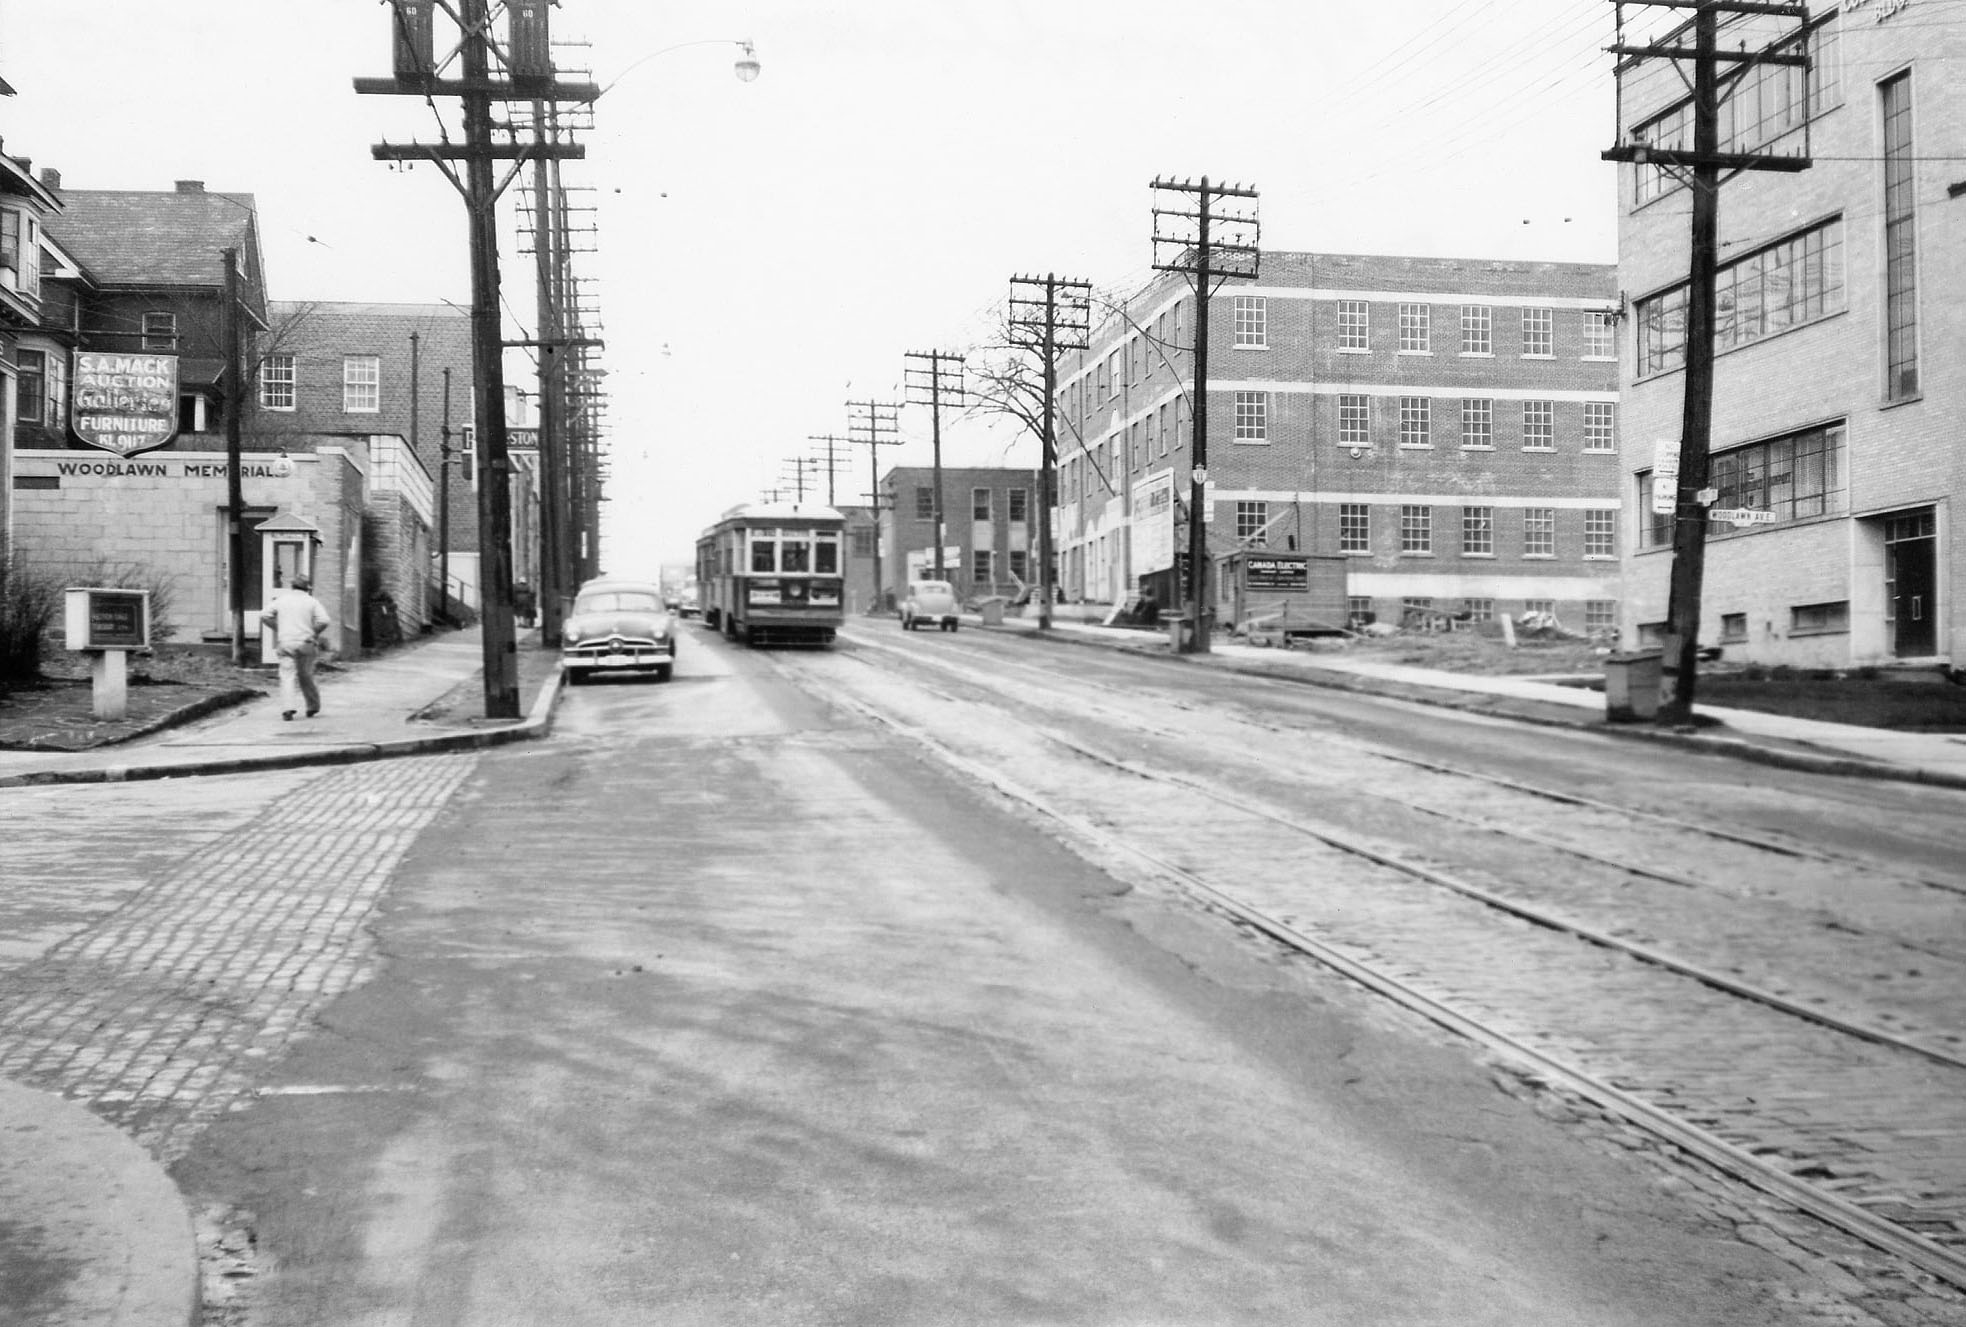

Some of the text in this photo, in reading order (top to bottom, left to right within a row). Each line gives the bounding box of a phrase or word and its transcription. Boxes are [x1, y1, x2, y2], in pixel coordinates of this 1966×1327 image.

[79, 374, 170, 388] AUCTION
[76, 388, 171, 411] Galleries
[79, 416, 168, 432] FURNITURE
[58, 462, 279, 479] WOODLAWN MEMRIAL
[1711, 510, 1751, 521] WOODLAWN
